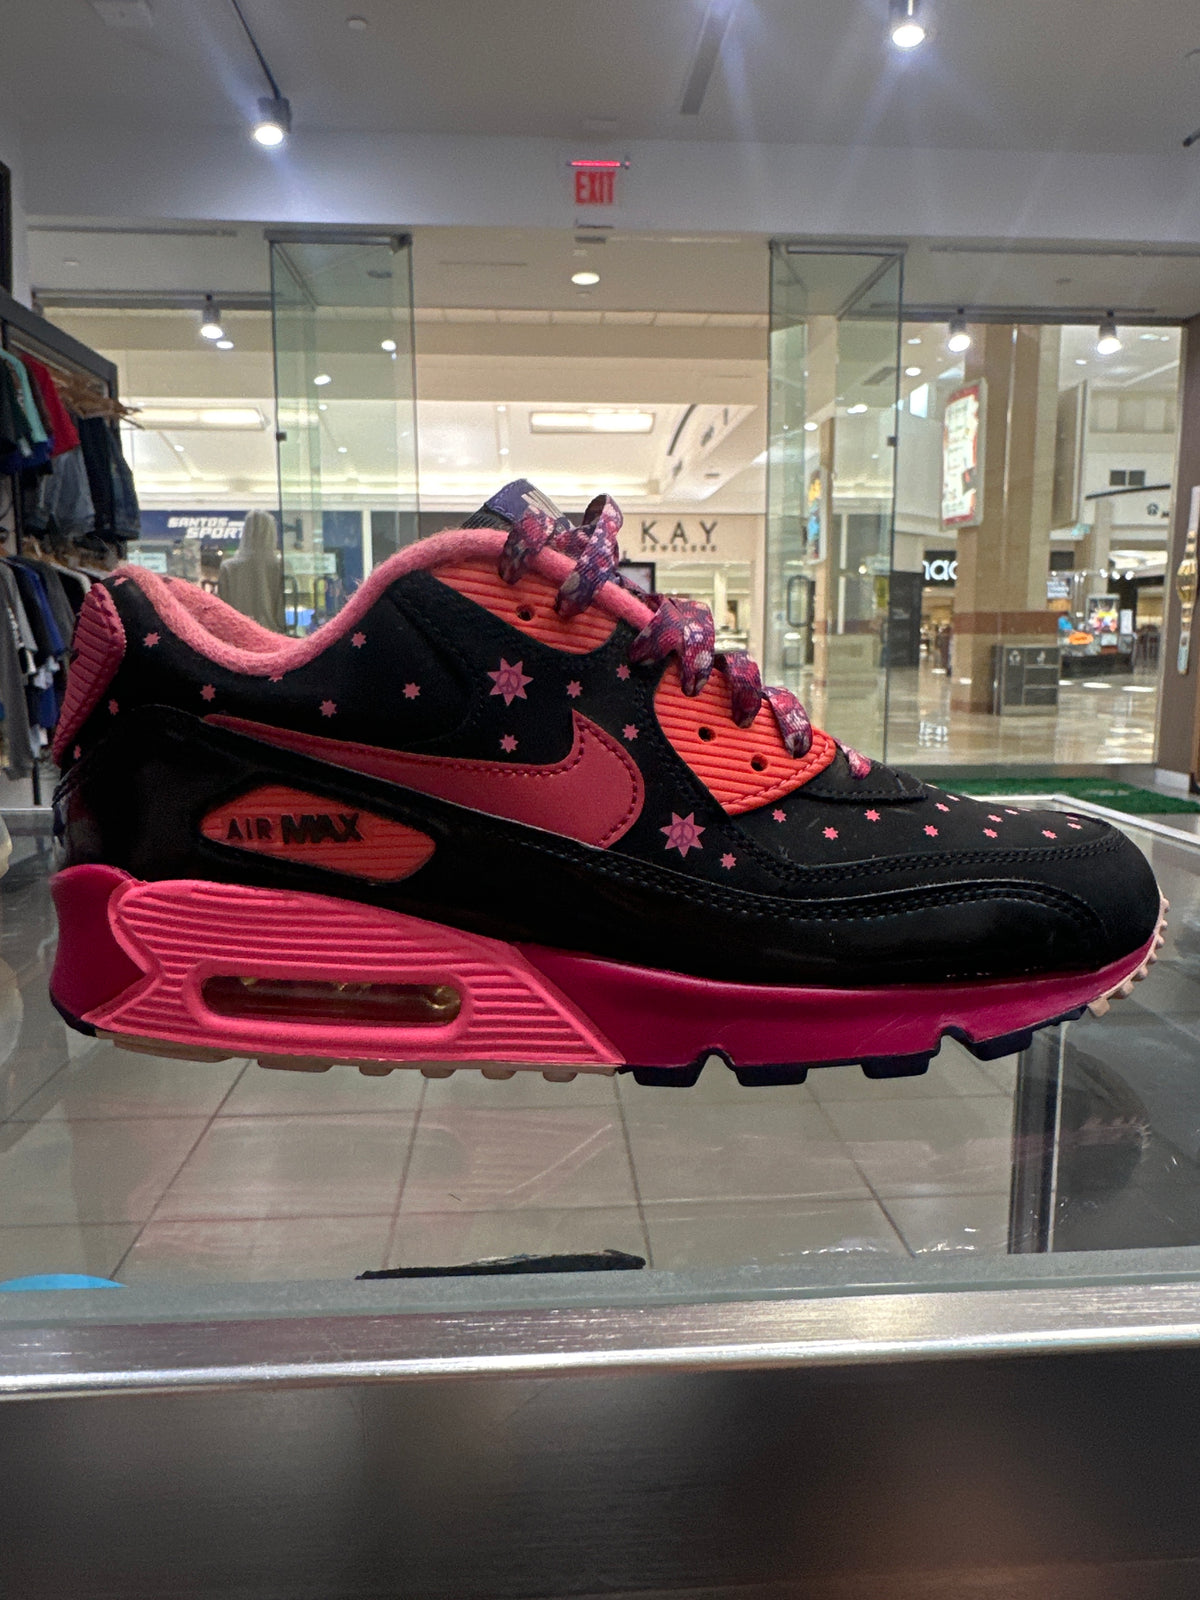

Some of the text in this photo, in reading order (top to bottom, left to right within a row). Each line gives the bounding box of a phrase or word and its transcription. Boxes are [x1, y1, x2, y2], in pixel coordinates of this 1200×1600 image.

[575, 171, 615, 204] EXIT
[167, 517, 229, 528] SANTOS
[640, 520, 718, 544] KAY
[226, 813, 365, 845] AIR MAX
